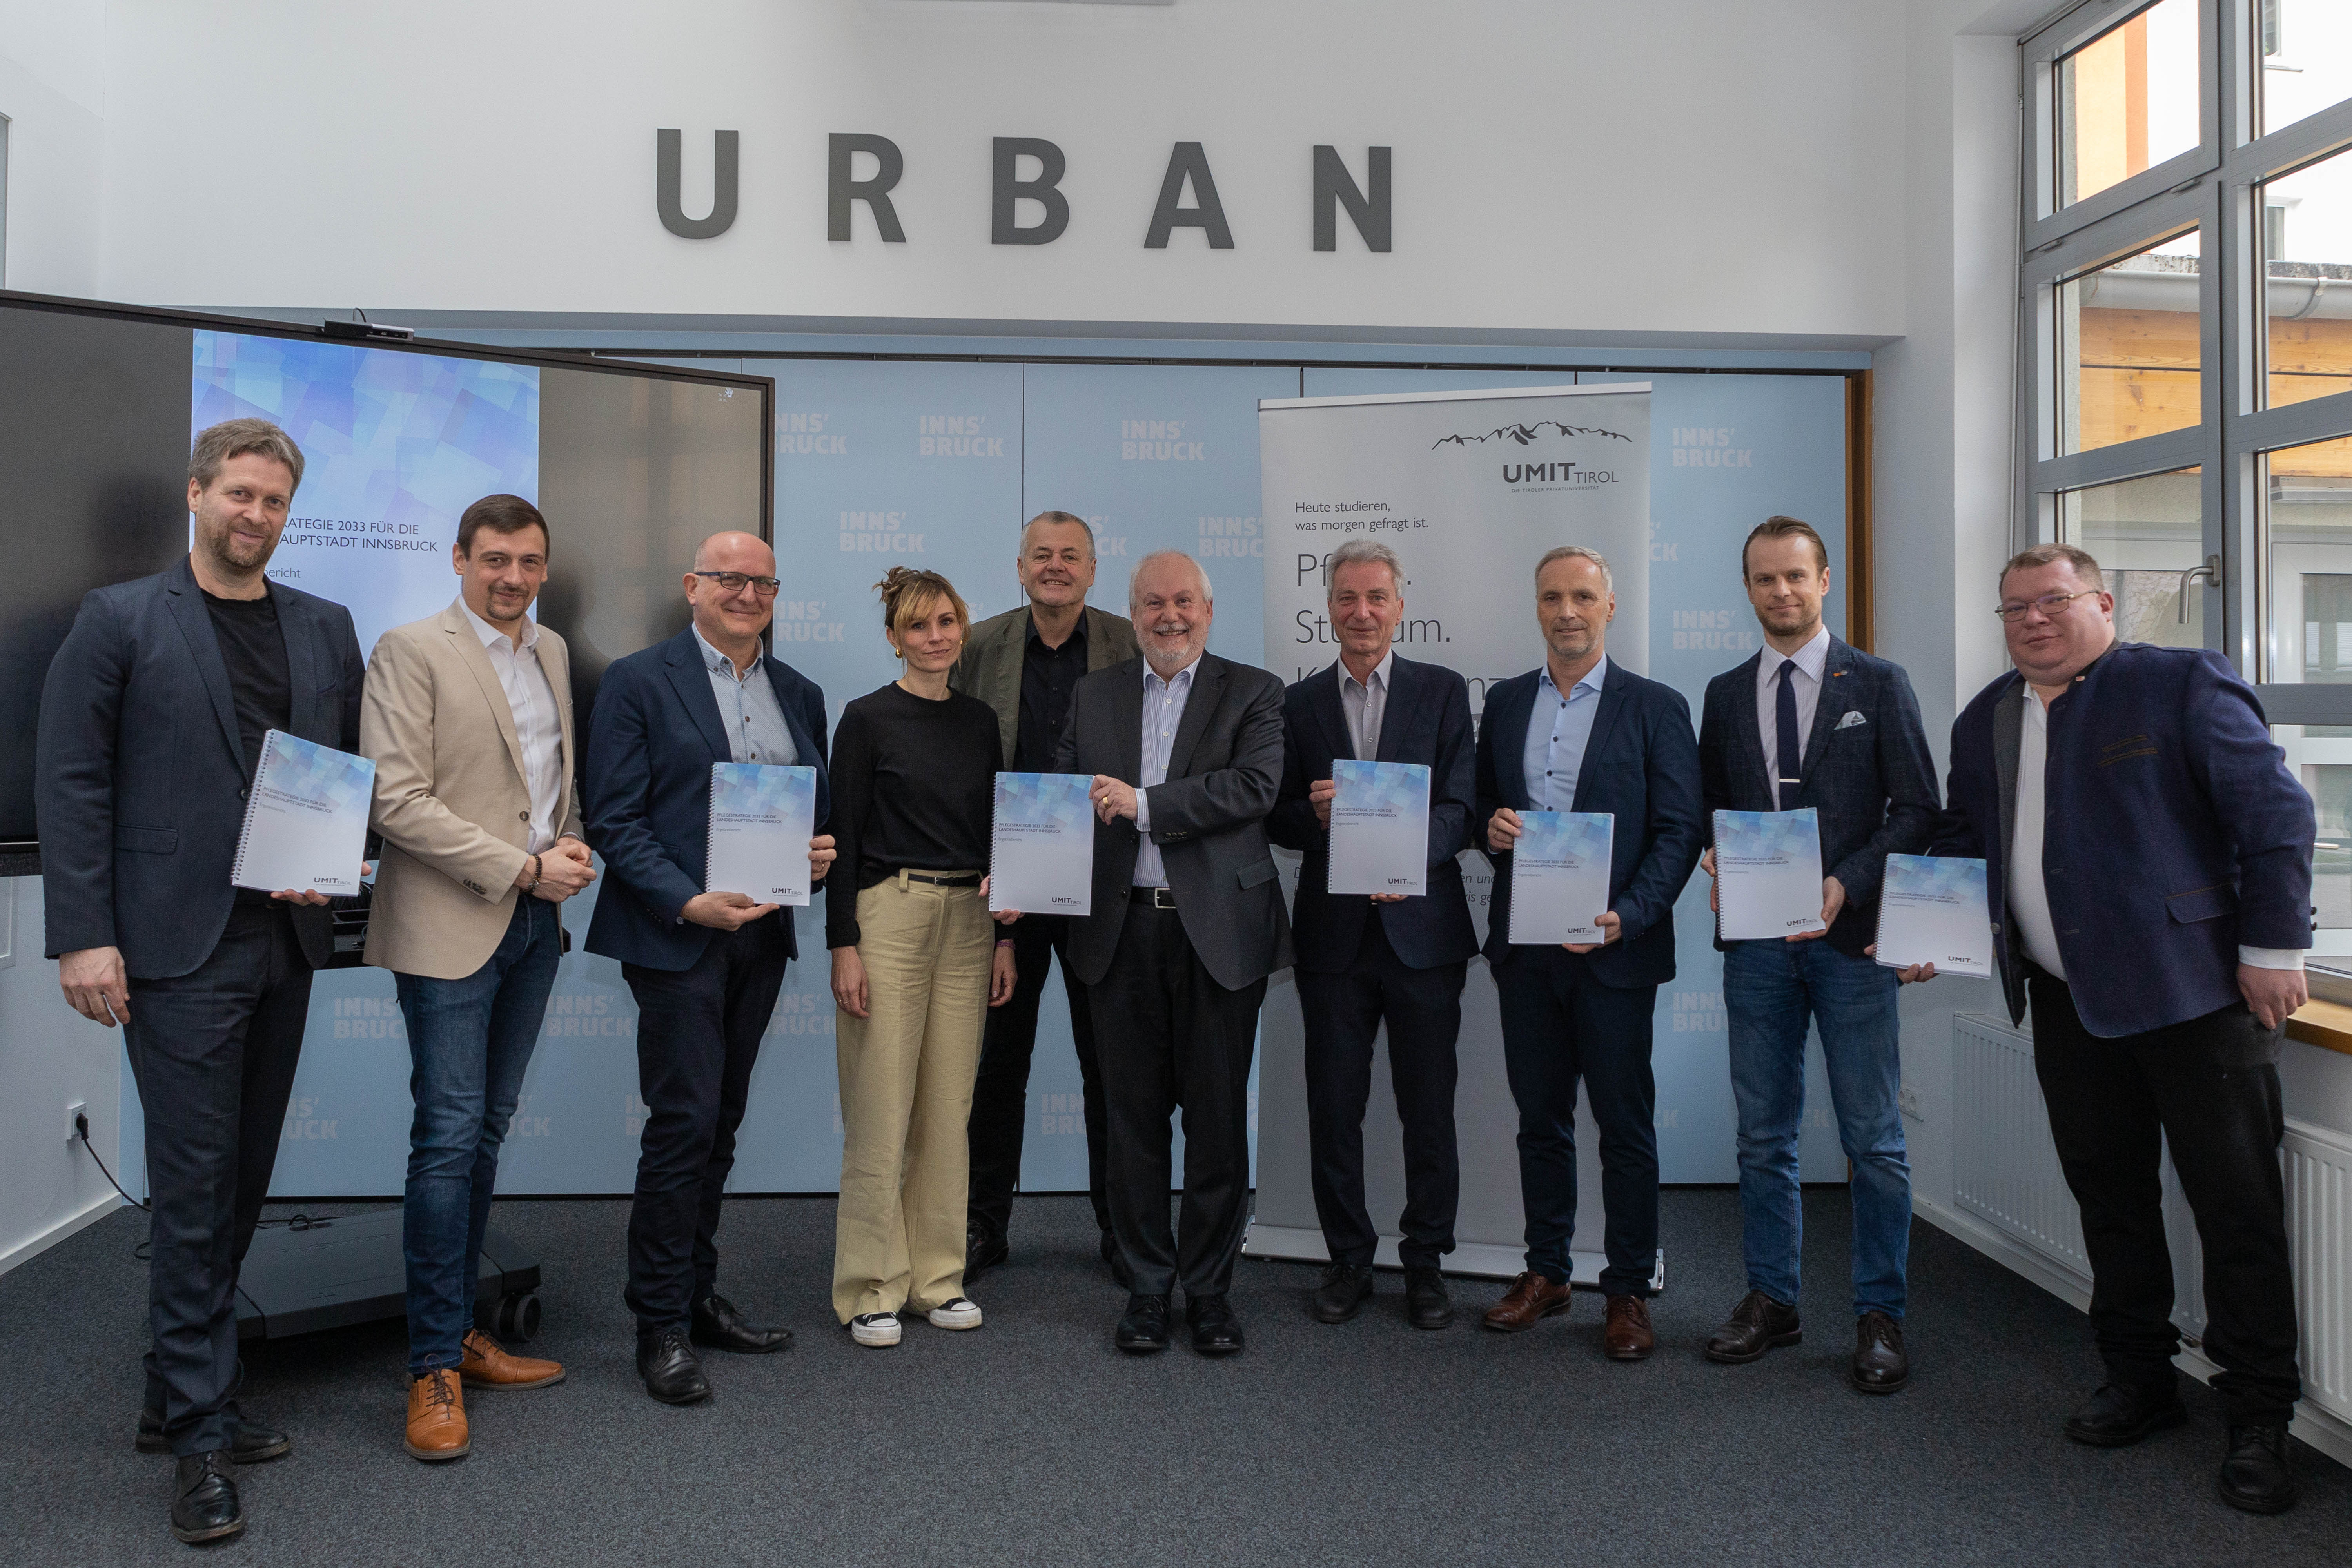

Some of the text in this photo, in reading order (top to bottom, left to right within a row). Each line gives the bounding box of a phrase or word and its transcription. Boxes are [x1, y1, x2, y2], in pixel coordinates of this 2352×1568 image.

[657, 128, 1391, 252] URBAN
[774, 414, 829, 432] NNS'
[920, 416, 985, 435] INNS'
[1122, 420, 1187, 439] INNS'
[775, 434, 847, 454] RUCK
[920, 437, 1003, 456] BRUCK
[1673, 428, 1735, 447] INNS'
[1122, 441, 1204, 461] BRUCK
[1673, 449, 1753, 468] BRUCK
[1503, 463, 1619, 483] UMIT TIROL
[1296, 500, 1390, 513] Heute studieren,
[284, 518, 419, 535] ATEGIE 2033 FÜR DIE
[840, 512, 906, 531] INNS'
[1295, 517, 1429, 533] was morgen gefragt ist.
[279, 534, 438, 552] AUPTSTADT INNSBRUCK
[840, 533, 924, 552] BRUCK
[1198, 538, 1262, 557] BRUC
[774, 601, 826, 620] NNS'
[1673, 610, 1736, 629] INNS'
[776, 622, 846, 641] RUCK
[1673, 632, 1753, 650] BRUCK
[335, 998, 397, 1017] INNS
[1673, 992, 1727, 1011] INNS
[334, 1020, 406, 1039] BRUC
[547, 1017, 632, 1036] BRUCK
[767, 1015, 836, 1034] RUCK
[1673, 1013, 1729, 1032] BRU
[1042, 1094, 1084, 1112] INN
[287, 1120, 338, 1140] UCK
[1042, 1116, 1089, 1134] BRU
